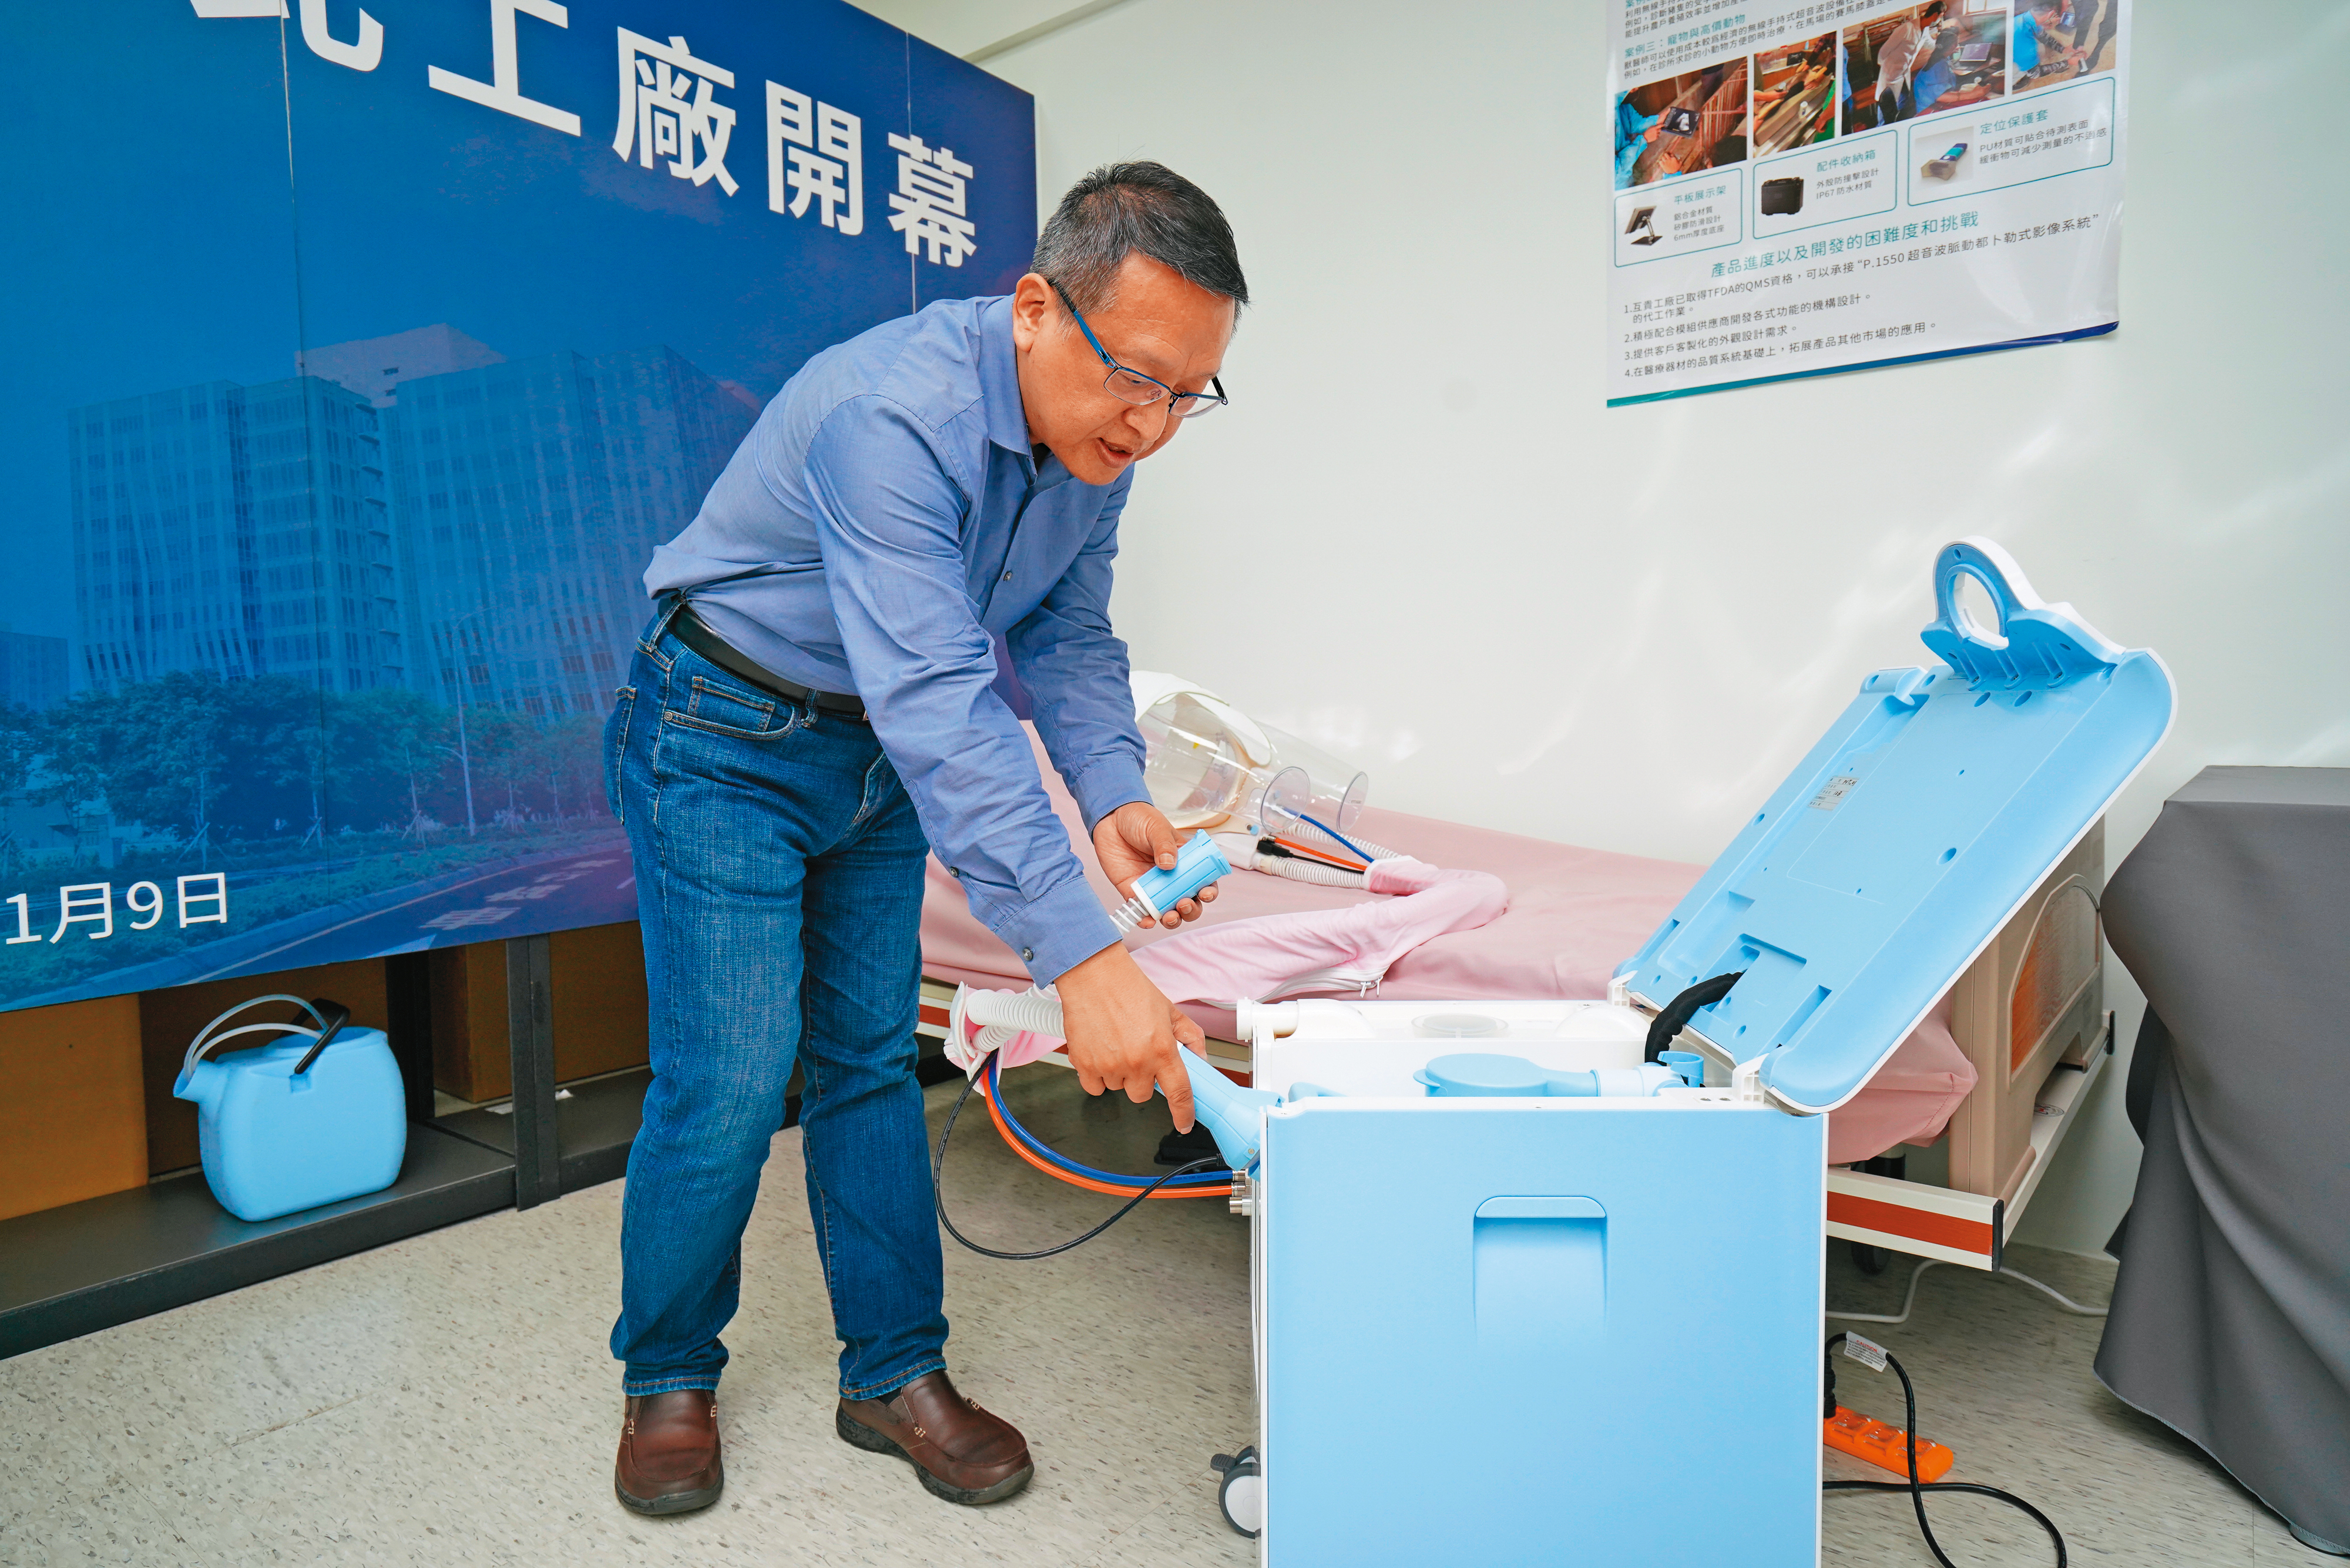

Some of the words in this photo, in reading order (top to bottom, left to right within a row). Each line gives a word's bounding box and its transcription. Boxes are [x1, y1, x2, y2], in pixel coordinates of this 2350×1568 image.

[1980, 109, 2049, 135] 定位保護套
[190, 0, 978, 267] 工廠開幕
[1980, 120, 2089, 152] PU材質可貼合待測表面
[1817, 149, 1876, 172] 配件收納箱
[1817, 167, 1879, 189] 外殼防撞擊設計
[1674, 186, 1726, 205] 平板展示架
[1817, 189, 1834, 199] IP67
[1837, 180, 1872, 195] 防水材質
[1674, 206, 1713, 221] 鋁合金材質
[1674, 215, 1721, 231] 矽膠防滑設計
[1674, 225, 1724, 241] 6mm厚度底座
[1711, 211, 1979, 278] 產品進度以及開發的困難度和挑戰
[1633, 306, 1694, 324] 的代工作業。
[5, 872, 228, 945] 1月9日
[1856, 1340, 1877, 1352] CAUTION
